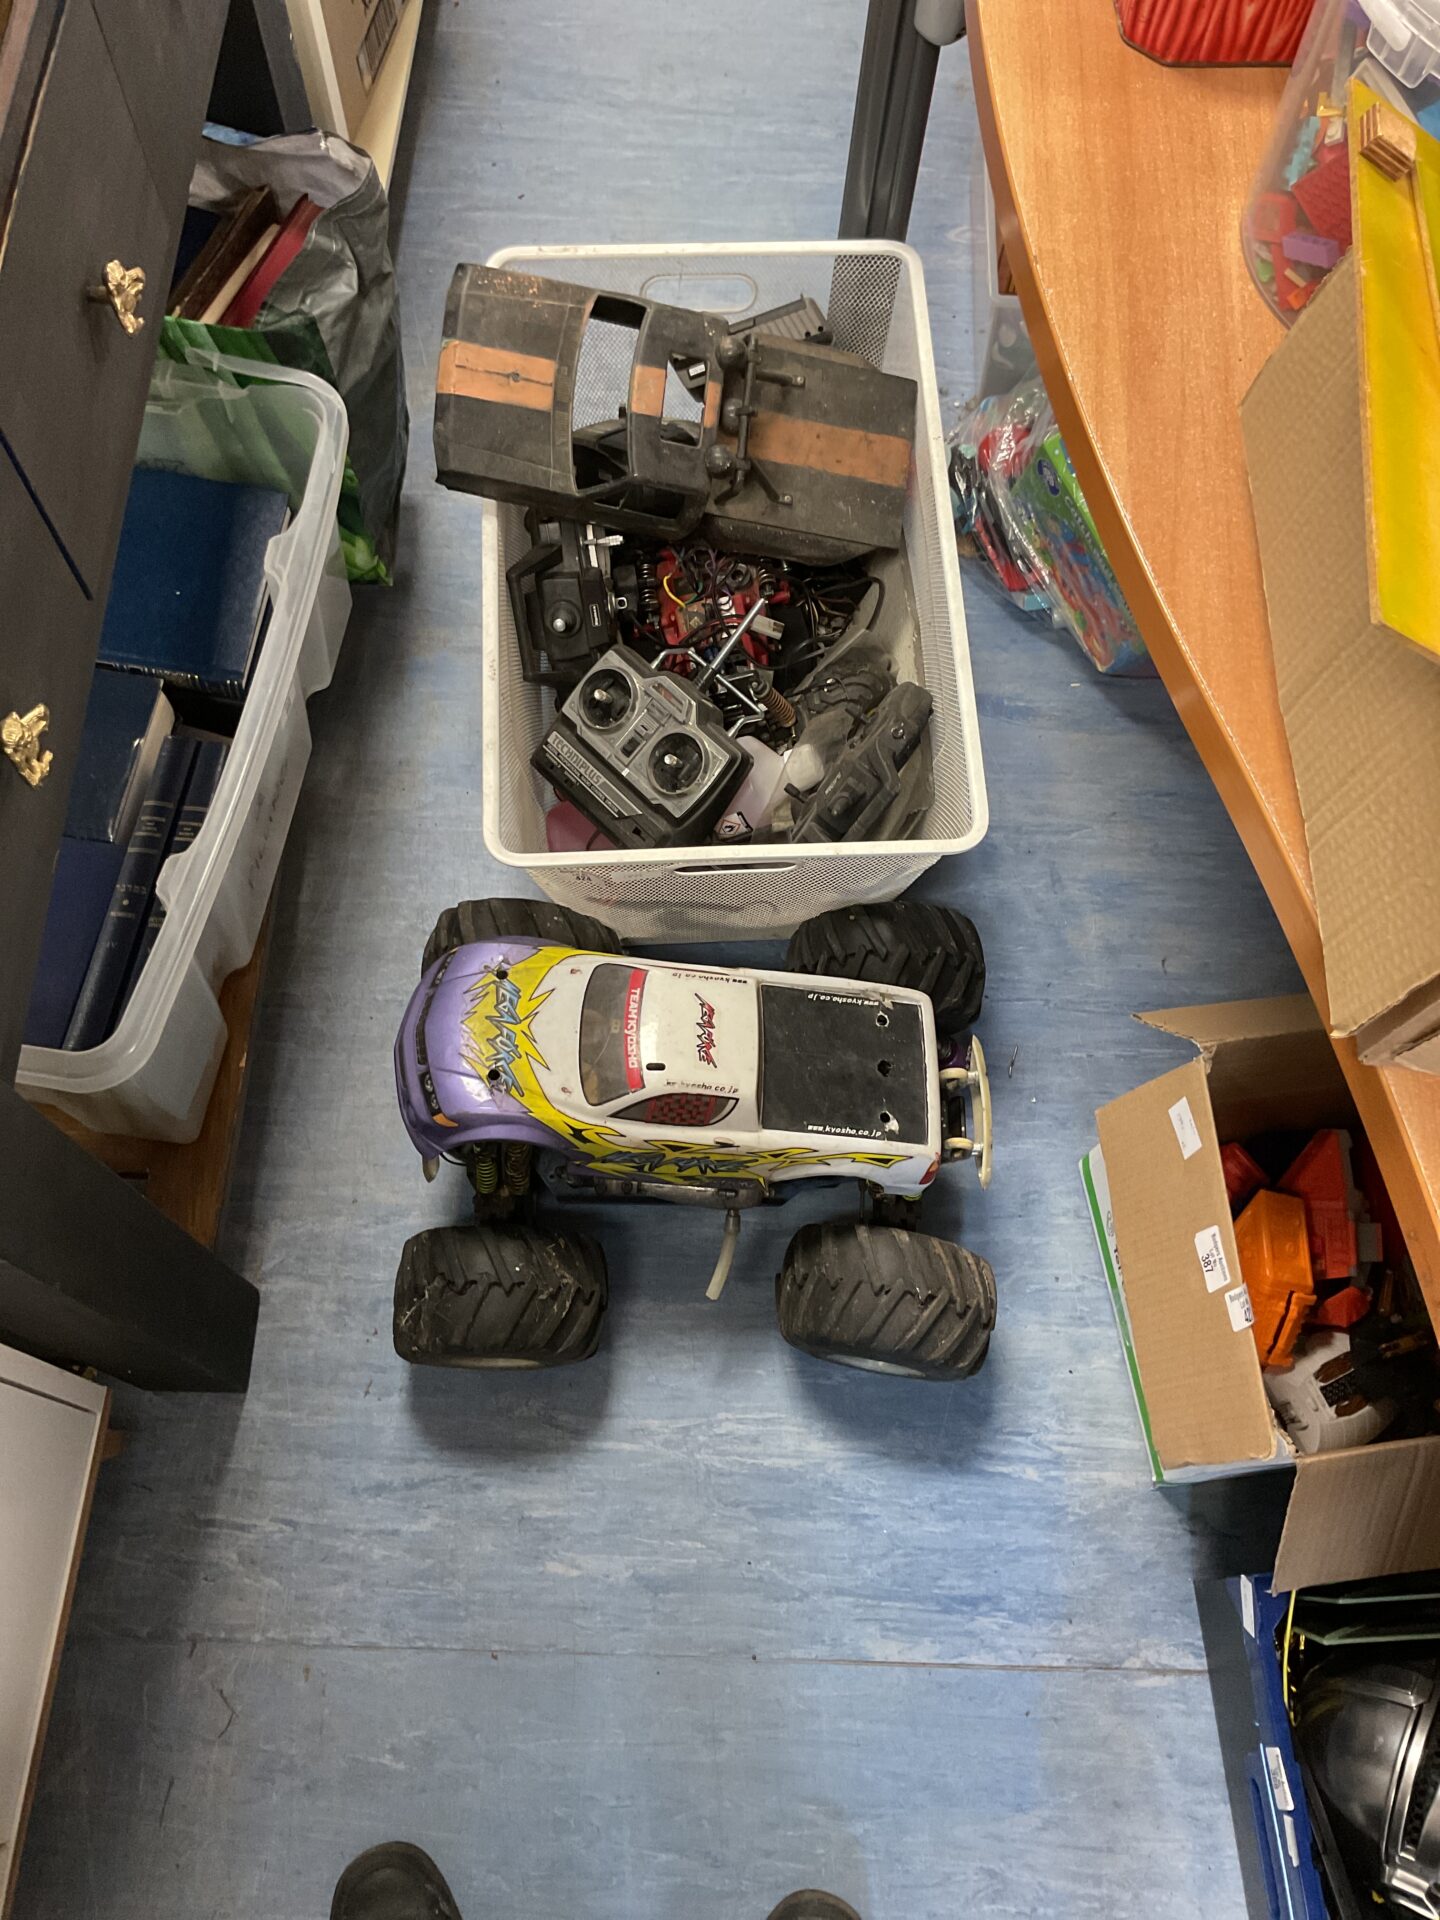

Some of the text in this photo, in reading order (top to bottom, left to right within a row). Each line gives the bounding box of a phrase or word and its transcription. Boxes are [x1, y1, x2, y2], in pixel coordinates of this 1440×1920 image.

[551, 734, 603, 785] TECHNIPLUS
[806, 993, 880, 1006] www.kyosho.co.jp
[624, 987, 641, 1069] TEAM KYOSHO
[806, 1124, 882, 1138] www.kyosho.co.jp
[1201, 1253, 1214, 1273] 387
